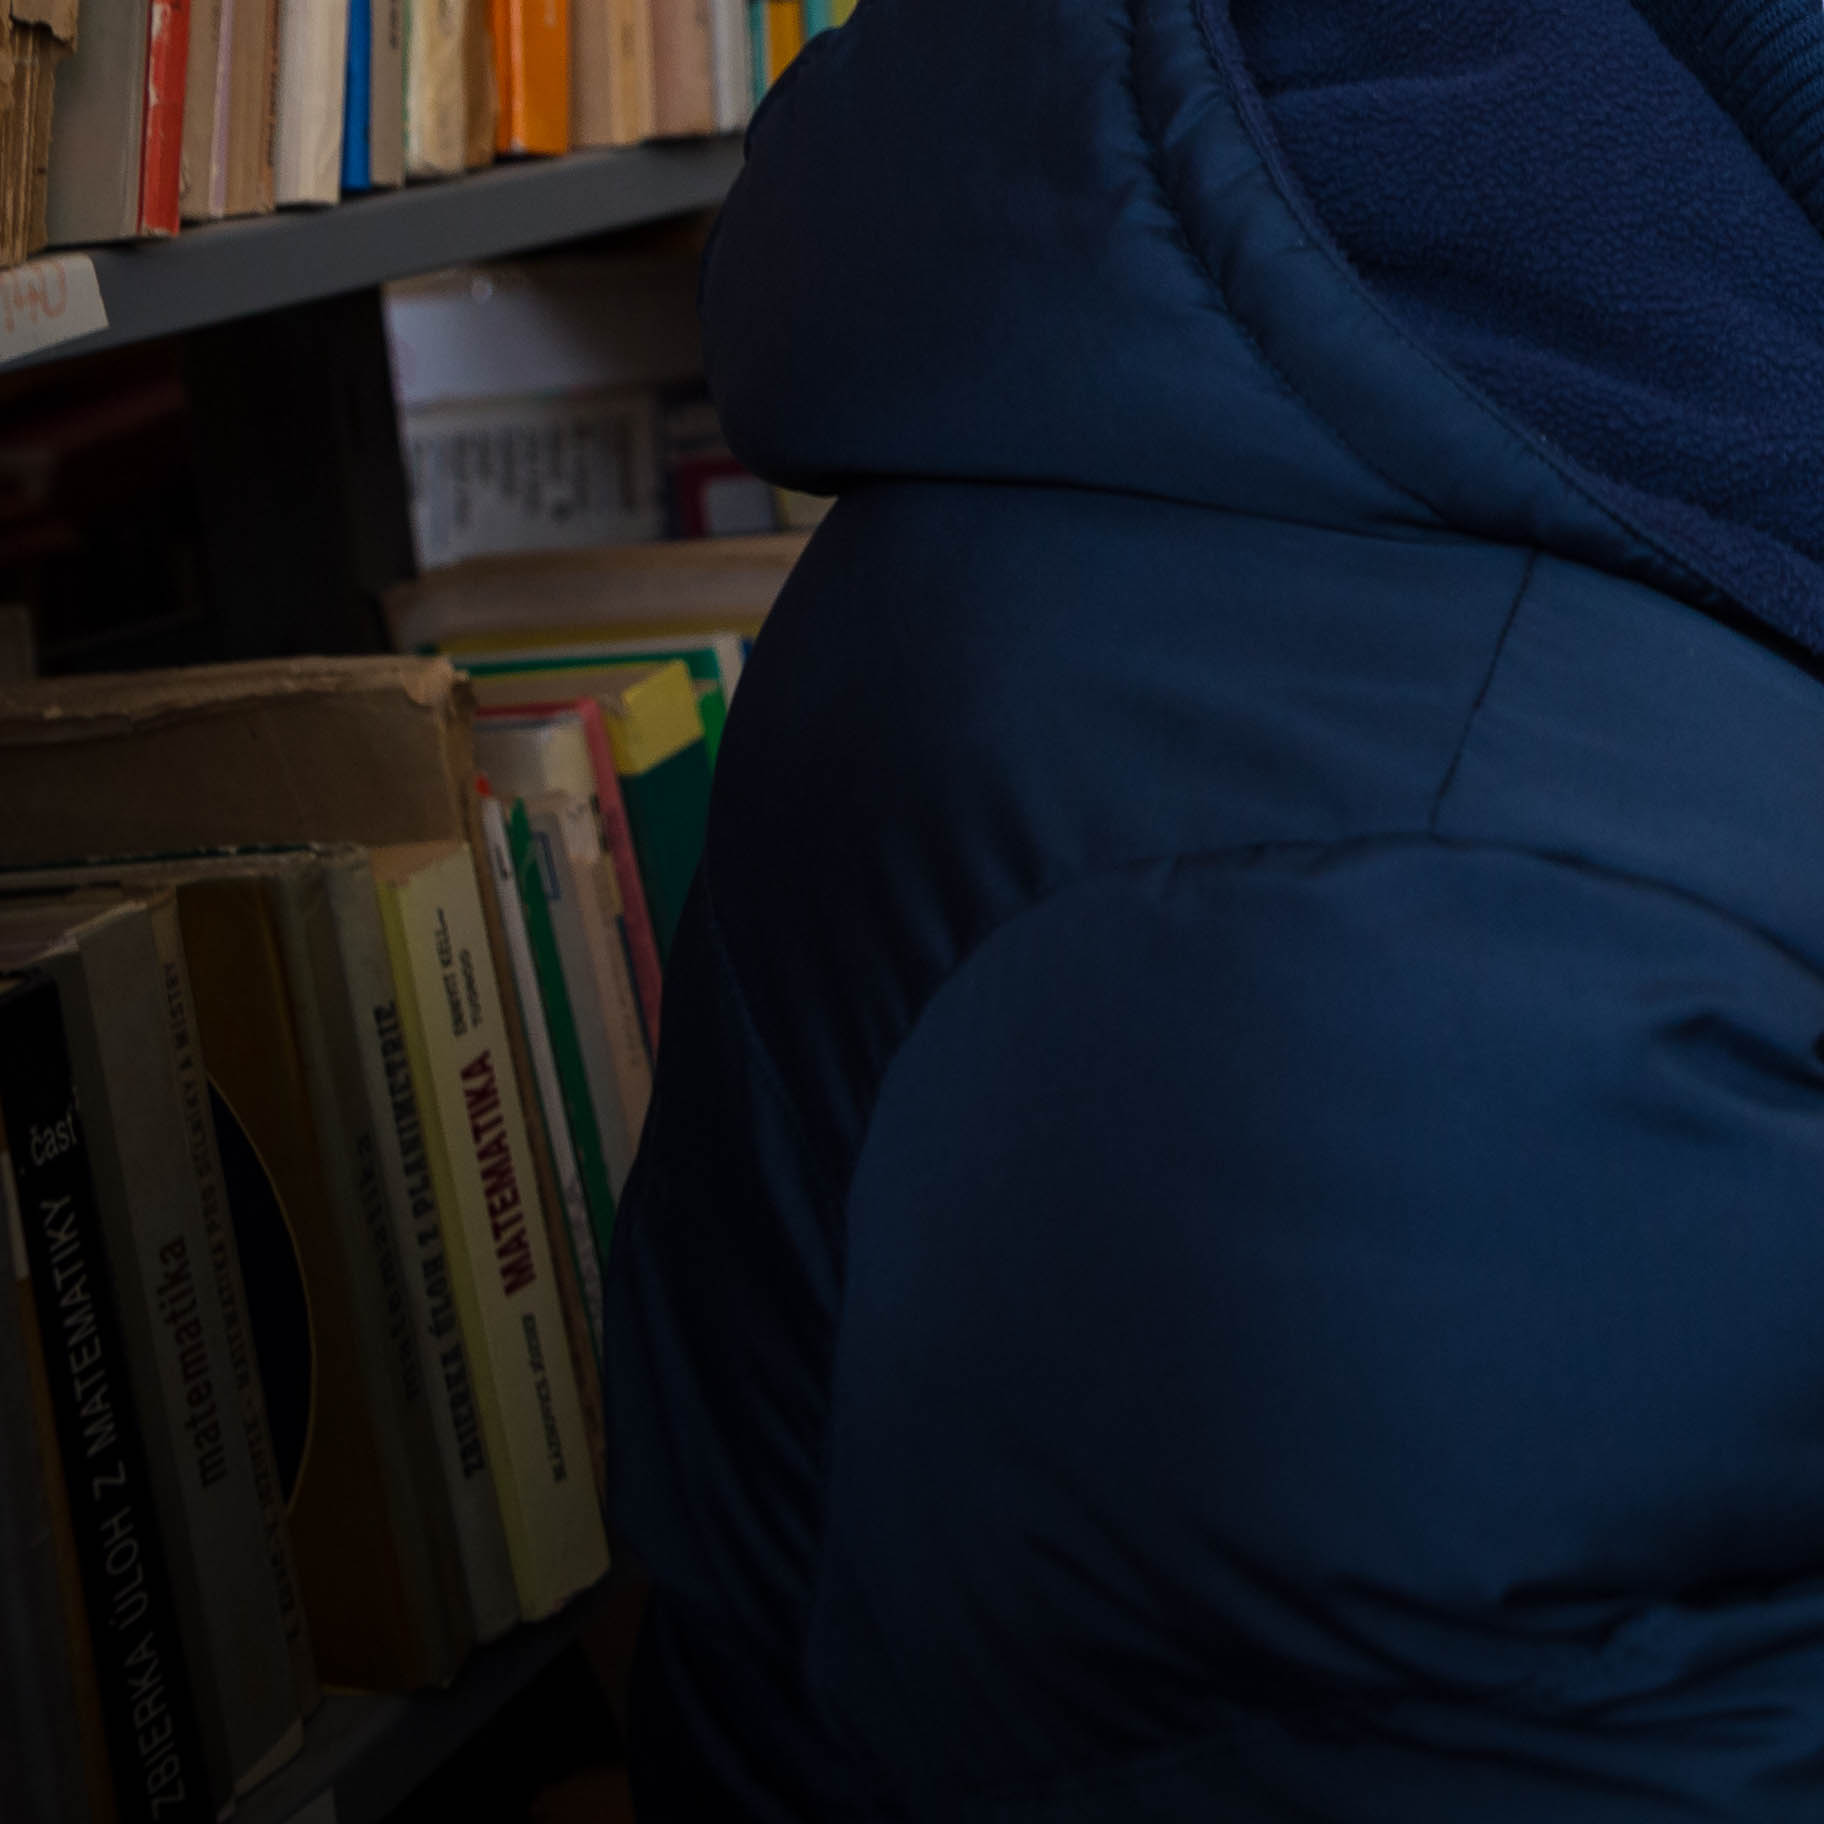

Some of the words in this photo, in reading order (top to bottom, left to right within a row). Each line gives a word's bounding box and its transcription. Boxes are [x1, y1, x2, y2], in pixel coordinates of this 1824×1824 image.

[370, 998, 435, 1217] PLANIMETRIE
[457, 1047, 535, 1297] MATEMATIKA
[37, 1191, 121, 1455] MATEMATIKY
[150, 1233, 230, 1490] matematika
[437, 1340, 487, 1480] ZBIERKA
[86, 1459, 132, 1499] Z
[89, 1504, 154, 1627] ÚLOH
[117, 1635, 188, 1820] ZBIERKA
